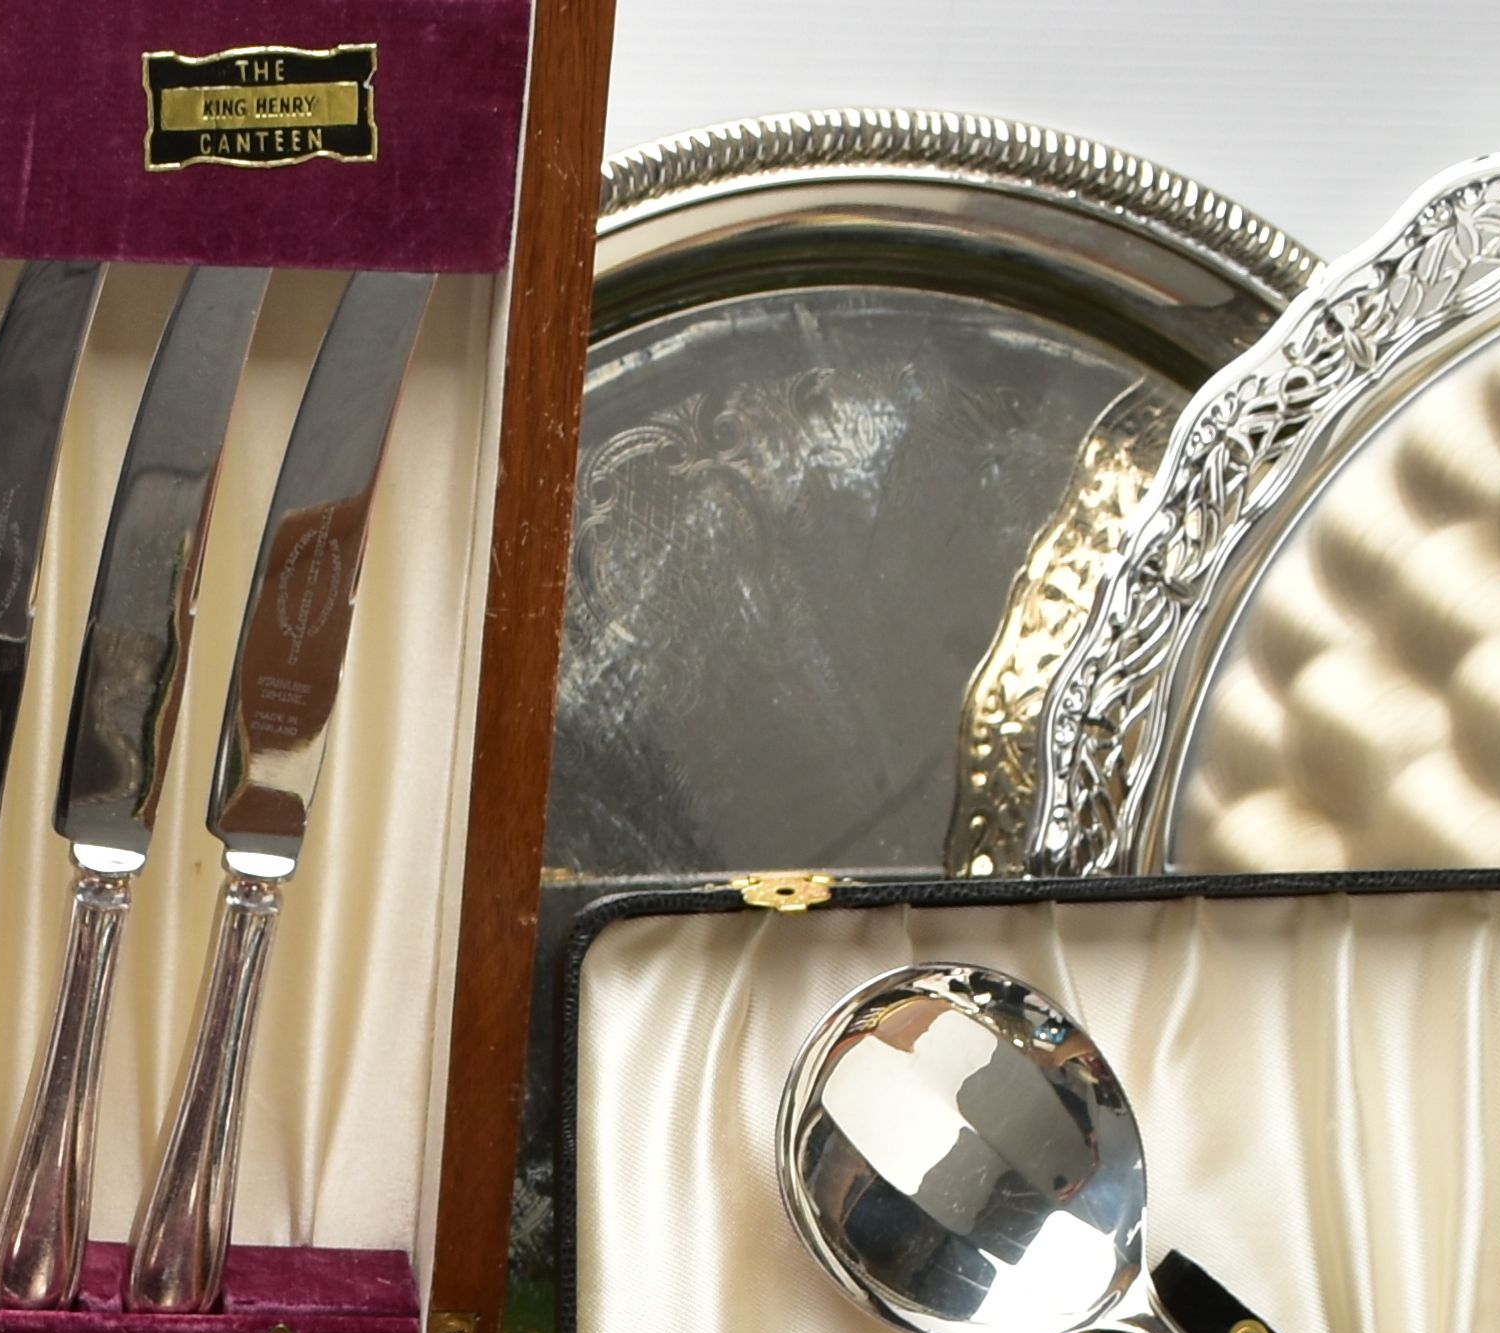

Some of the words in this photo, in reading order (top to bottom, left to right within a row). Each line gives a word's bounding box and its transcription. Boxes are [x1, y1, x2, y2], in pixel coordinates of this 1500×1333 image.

[234, 59, 285, 82] THE
[203, 98, 246, 116] KING
[256, 96, 316, 116] HENRY
[200, 129, 322, 155] CANTEEN
